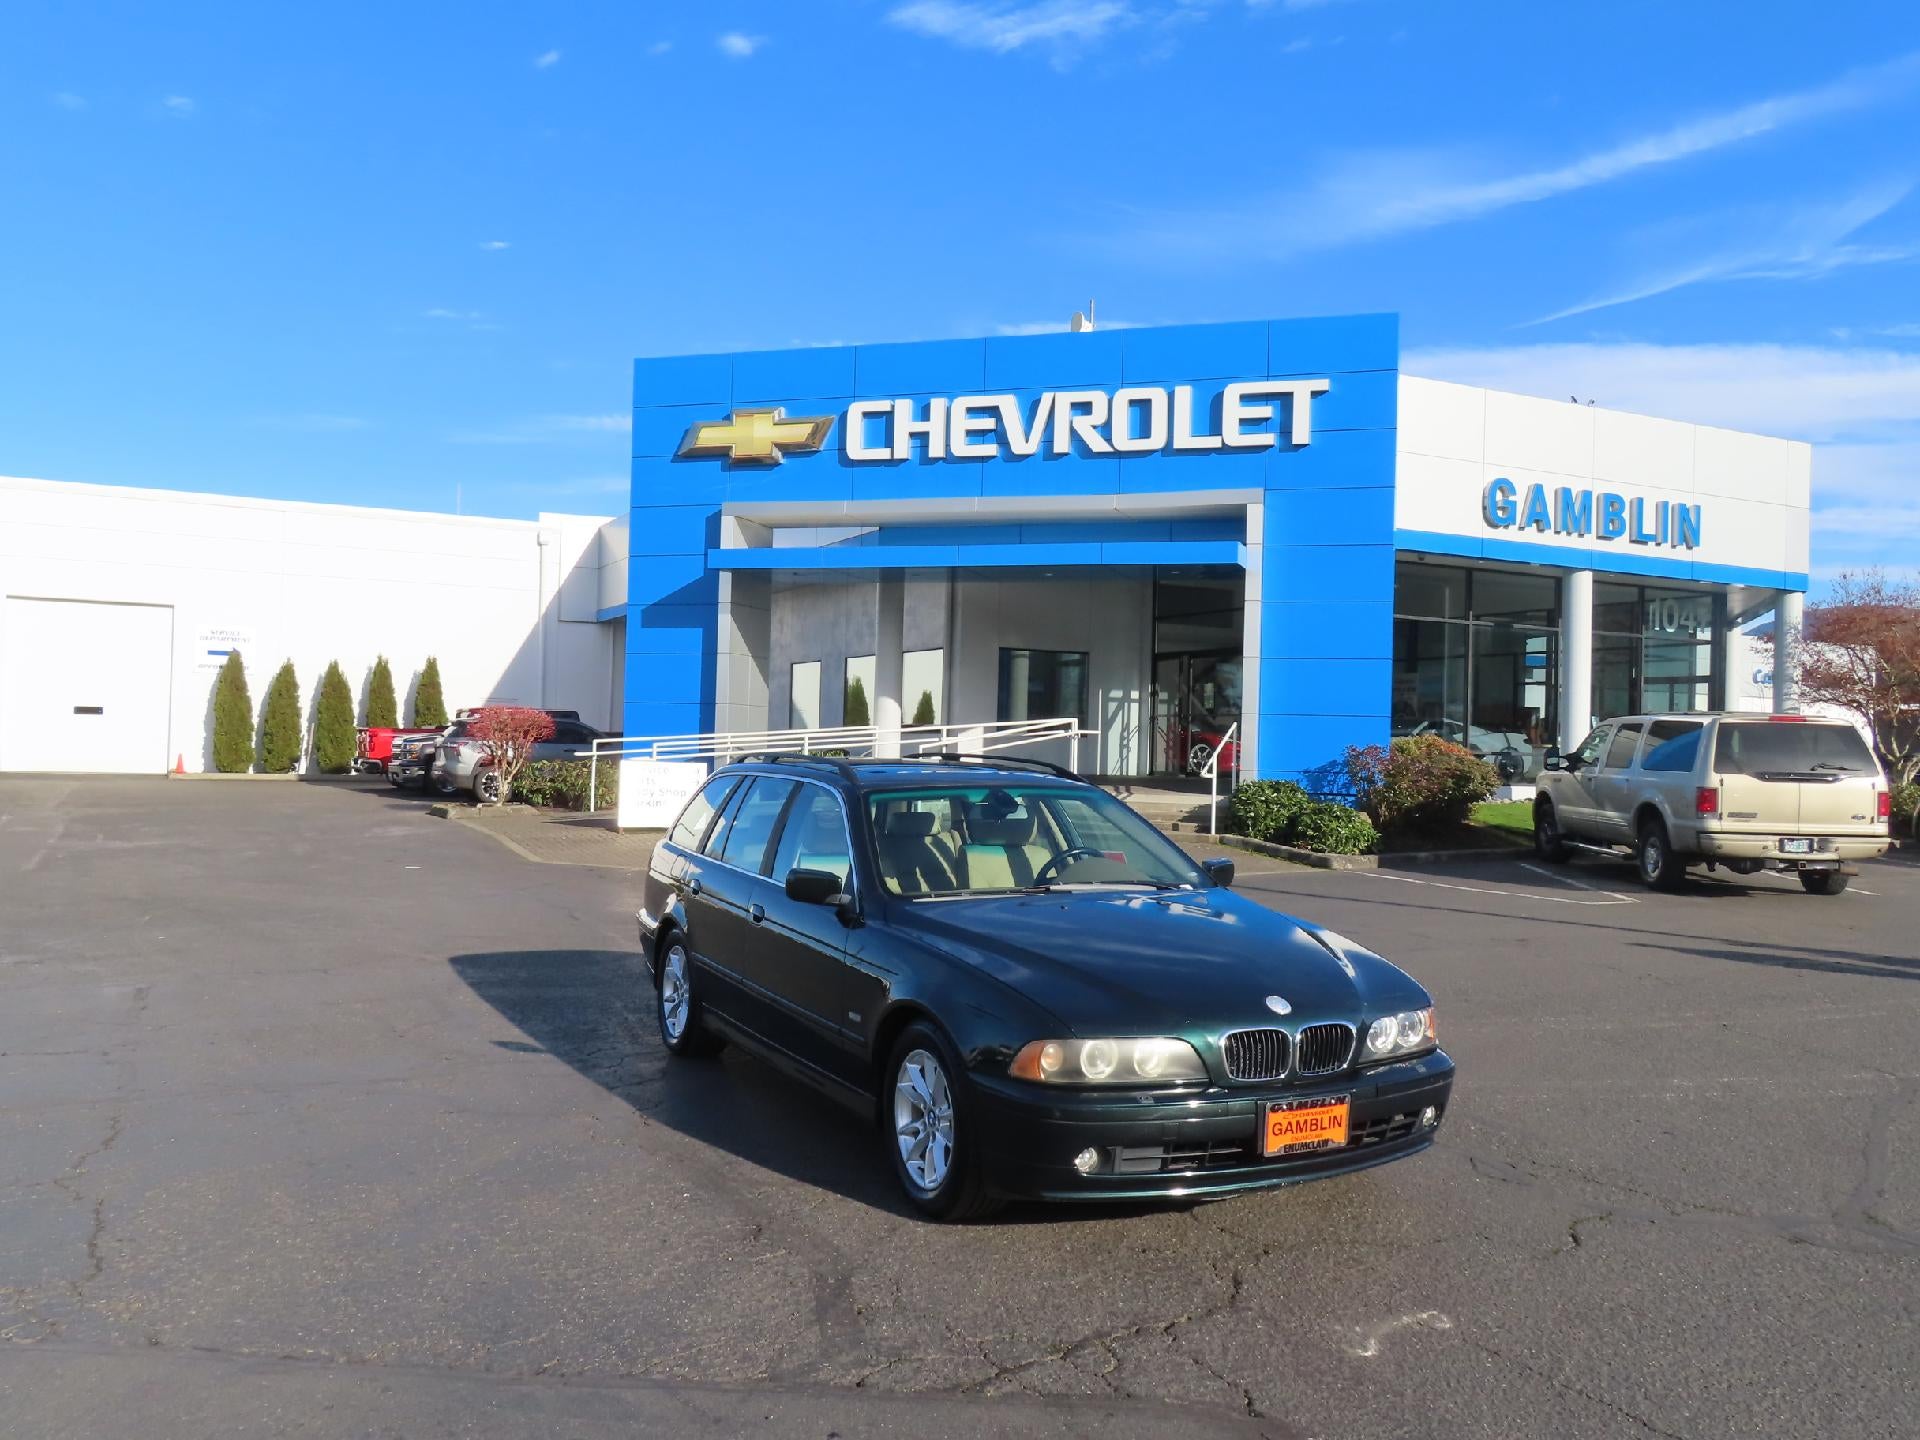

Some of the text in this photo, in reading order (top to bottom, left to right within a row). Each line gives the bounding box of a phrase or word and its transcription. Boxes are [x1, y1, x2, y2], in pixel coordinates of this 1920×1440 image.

[846, 378, 1330, 461] CHEVROLET
[1482, 477, 1702, 550] GAMBLIN
[658, 785, 687, 798] Shop
[1272, 1115, 1342, 1137] GAMBLIN
[1283, 1138, 1330, 1153] ENUMCLAW
